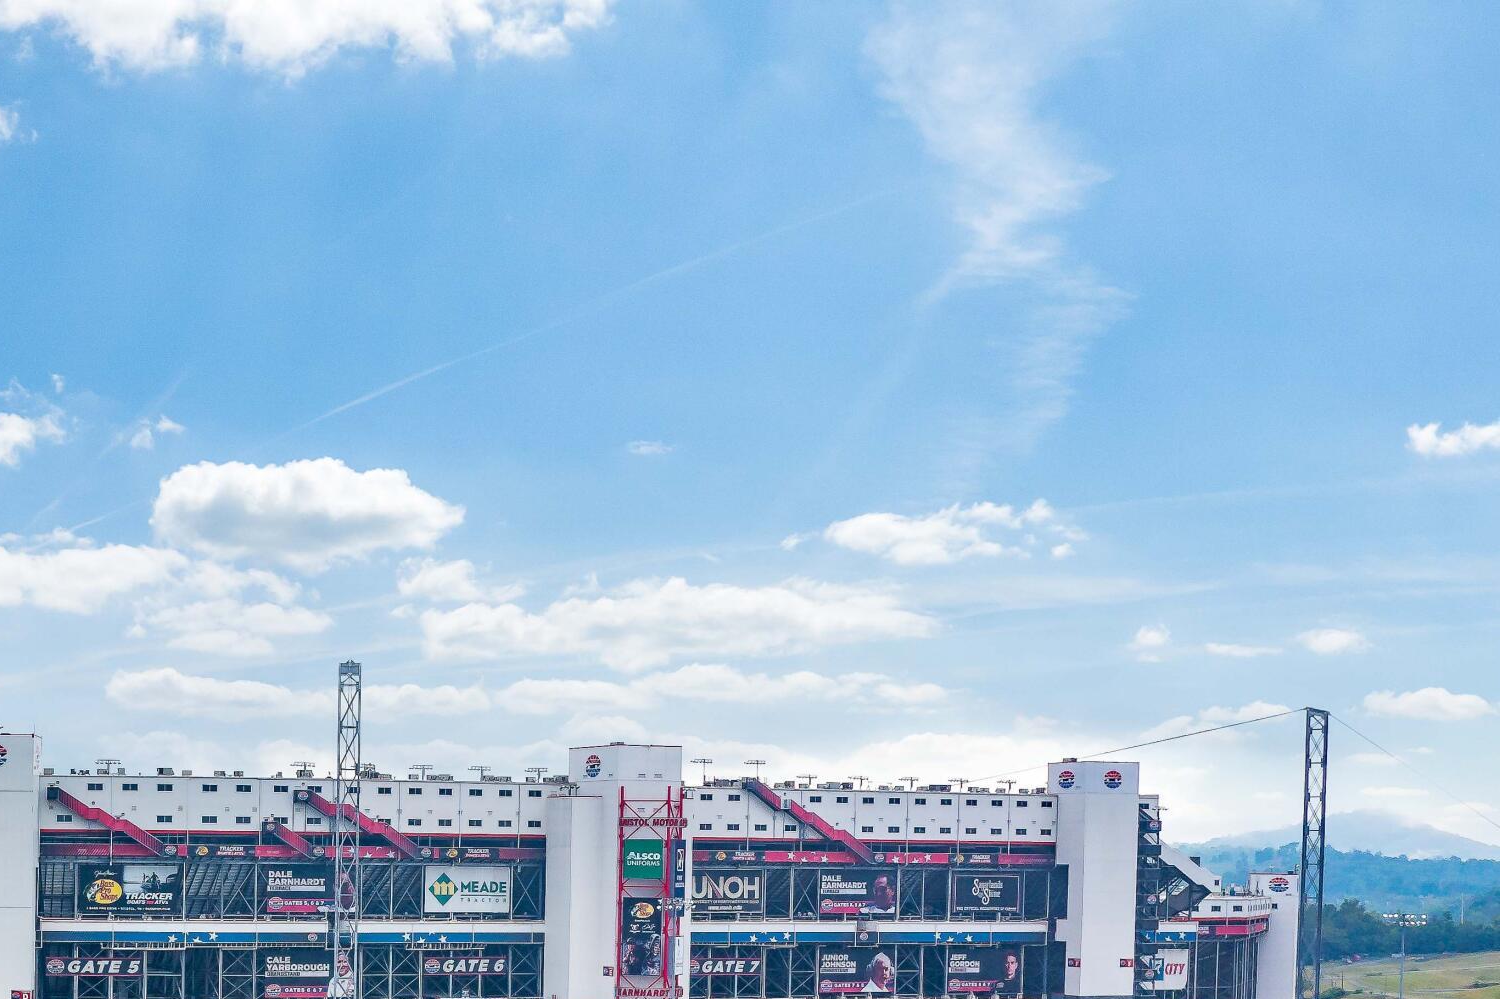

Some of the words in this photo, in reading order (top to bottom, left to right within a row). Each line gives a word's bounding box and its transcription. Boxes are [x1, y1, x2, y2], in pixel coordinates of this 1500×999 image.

[626, 851, 661, 861] ALSCO
[268, 870, 293, 878] DALE
[268, 878, 326, 886] EARNHARDT
[460, 880, 507, 893] MEADE
[692, 872, 760, 899] UNOH
[100, 893, 119, 902] Shops
[125, 892, 173, 900] TRACKER
[266, 956, 291, 964] CALE
[820, 960, 857, 968] JOHNSON
[67, 960, 122, 974] GATE
[127, 960, 140, 974] 5
[442, 959, 490, 973] GATE
[493, 959, 505, 973] 6
[701, 960, 746, 973] GATE
[749, 960, 760, 973] 7
[1164, 963, 1186, 976] CITY
[22, 992, 29, 999] D
